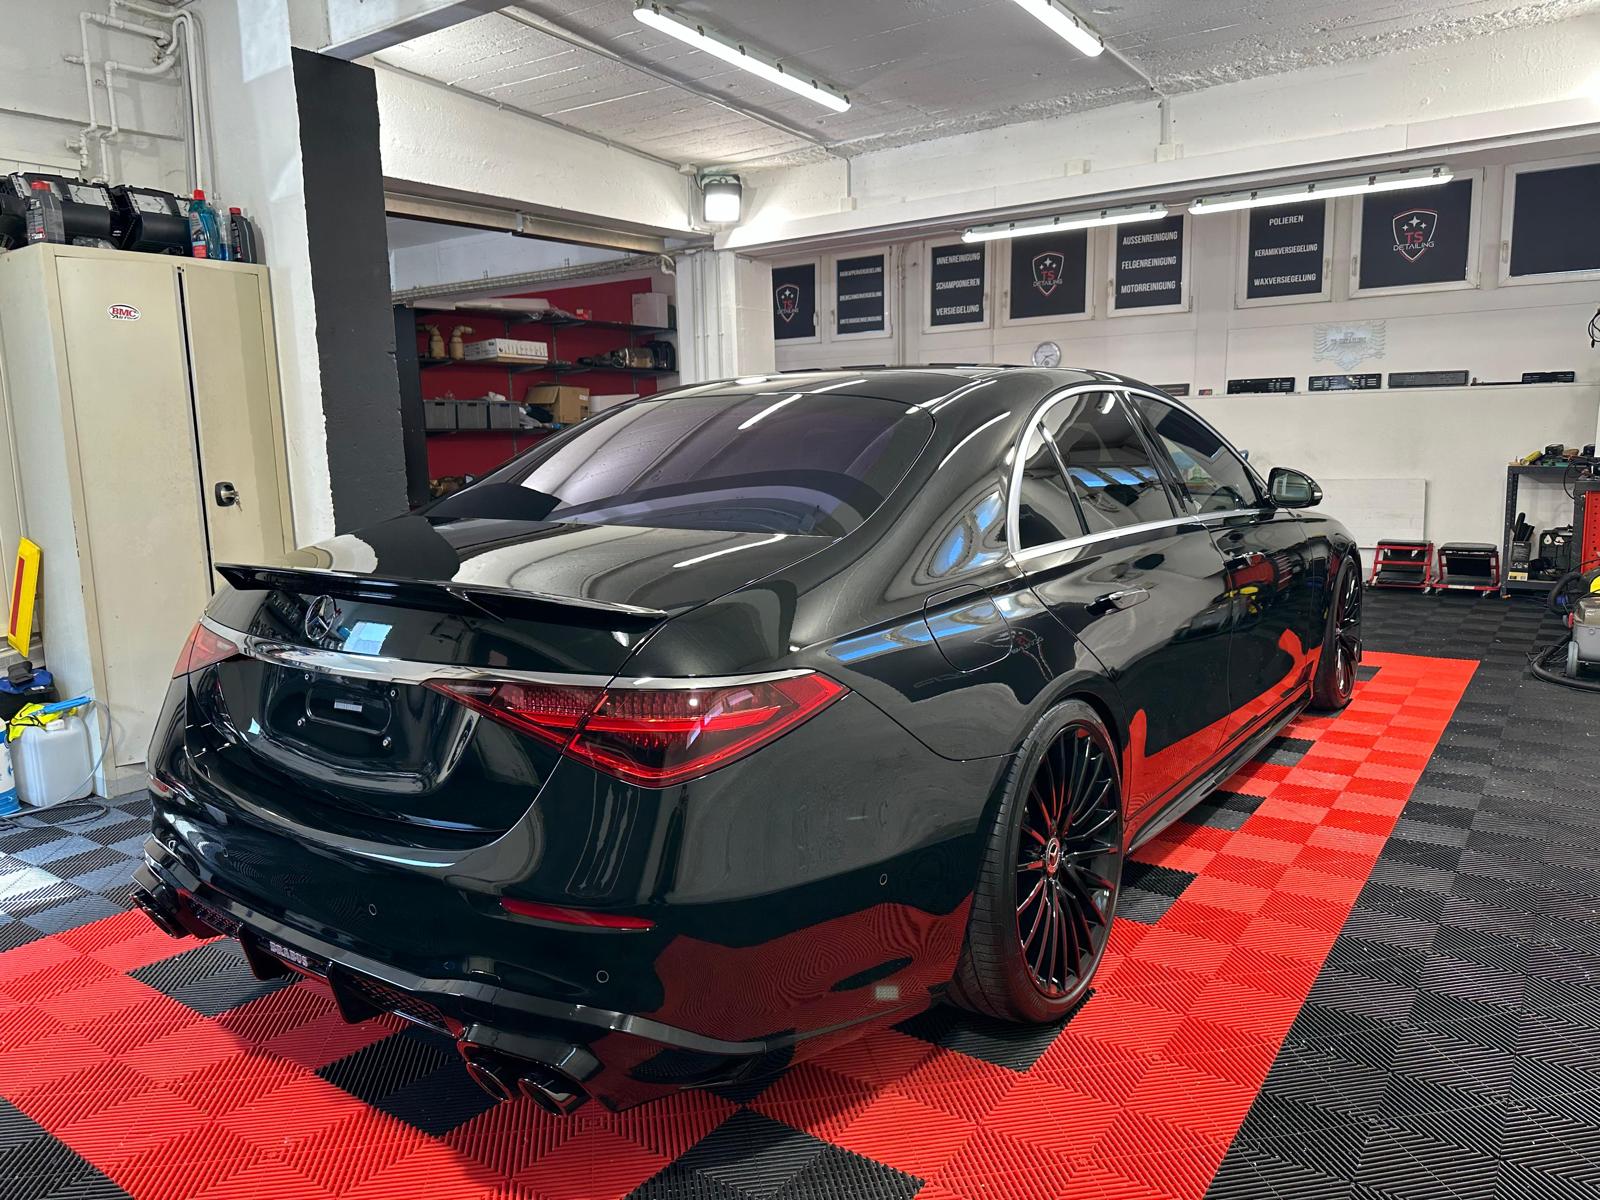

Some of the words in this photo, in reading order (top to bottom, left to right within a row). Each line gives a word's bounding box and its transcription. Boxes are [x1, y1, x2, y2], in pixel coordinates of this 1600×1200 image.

[1269, 214, 1304, 226] POLIEREN
[1122, 231, 1178, 246] AUSSENREINIGUNG
[1404, 231, 1424, 244] TS
[1254, 243, 1318, 257] KERAMIKVERSIEGELUNG
[1393, 241, 1435, 251] DETAILING
[936, 252, 981, 265] INNENREINIGUNG
[1121, 256, 1177, 270] FELGENREINIGUNG
[1041, 270, 1055, 281] TS
[1253, 273, 1317, 286] WAXVERSIEGELUNG
[1120, 281, 1176, 294] MOTORREINIGUNG
[112, 307, 137, 317] BMC
[936, 304, 980, 316] VERSIEGELUNG
[269, 941, 308, 967] BRABUS
